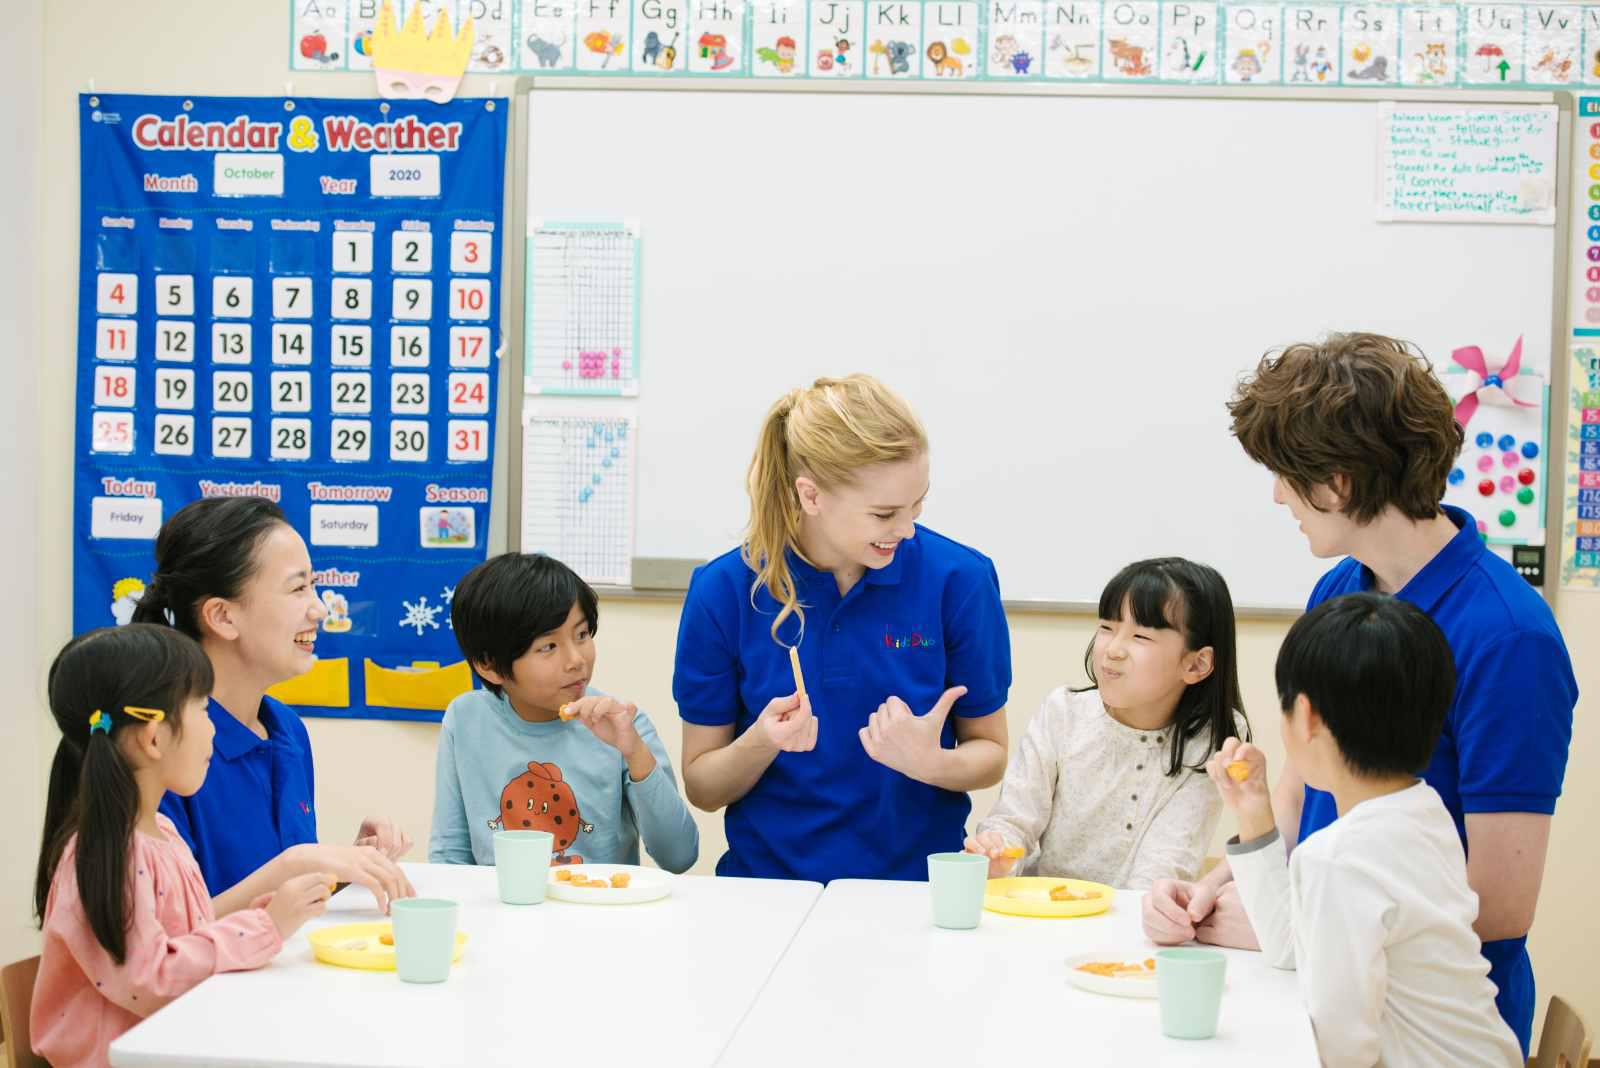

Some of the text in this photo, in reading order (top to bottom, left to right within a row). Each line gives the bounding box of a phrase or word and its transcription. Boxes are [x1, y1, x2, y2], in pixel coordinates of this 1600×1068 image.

[642, 0, 677, 29] Gg
[699, 2, 732, 21] Hh
[769, 3, 786, 24] Ii
[819, 3, 849, 34] Jj
[878, 4, 909, 25] Kk
[938, 4, 961, 26] Ll
[995, 5, 1036, 23] Mm
[1056, 5, 1089, 24] Nn
[1114, 5, 1150, 25] Oo
[1173, 5, 1205, 33] Pp
[1296, 10, 1327, 30] Rr
[1354, 10, 1382, 32] Ss
[1416, 10, 1441, 32] Tt
[1478, 8, 1511, 30] Uu
[1538, 9, 1568, 30] Vv
[134, 115, 460, 151] Calendar & Weather
[145, 166, 275, 192] Month October
[320, 169, 422, 194] Year 2020
[349, 242, 477, 263] 1 2 3
[111, 284, 483, 310] 4 5 6 7 8 9 10
[109, 330, 482, 357] 11 12 13 14 15 16 17
[104, 377, 483, 404] 18 19 20 21 22 23 24
[99, 422, 479, 451] 25 26 27 28 29 30 31
[102, 478, 155, 497] Today
[200, 480, 280, 501] Yesterday
[309, 483, 392, 501] Tomorrow
[426, 484, 488, 502] Season
[110, 511, 144, 525] Friday
[320, 518, 369, 532] Saturday
[314, 568, 359, 586] ather
